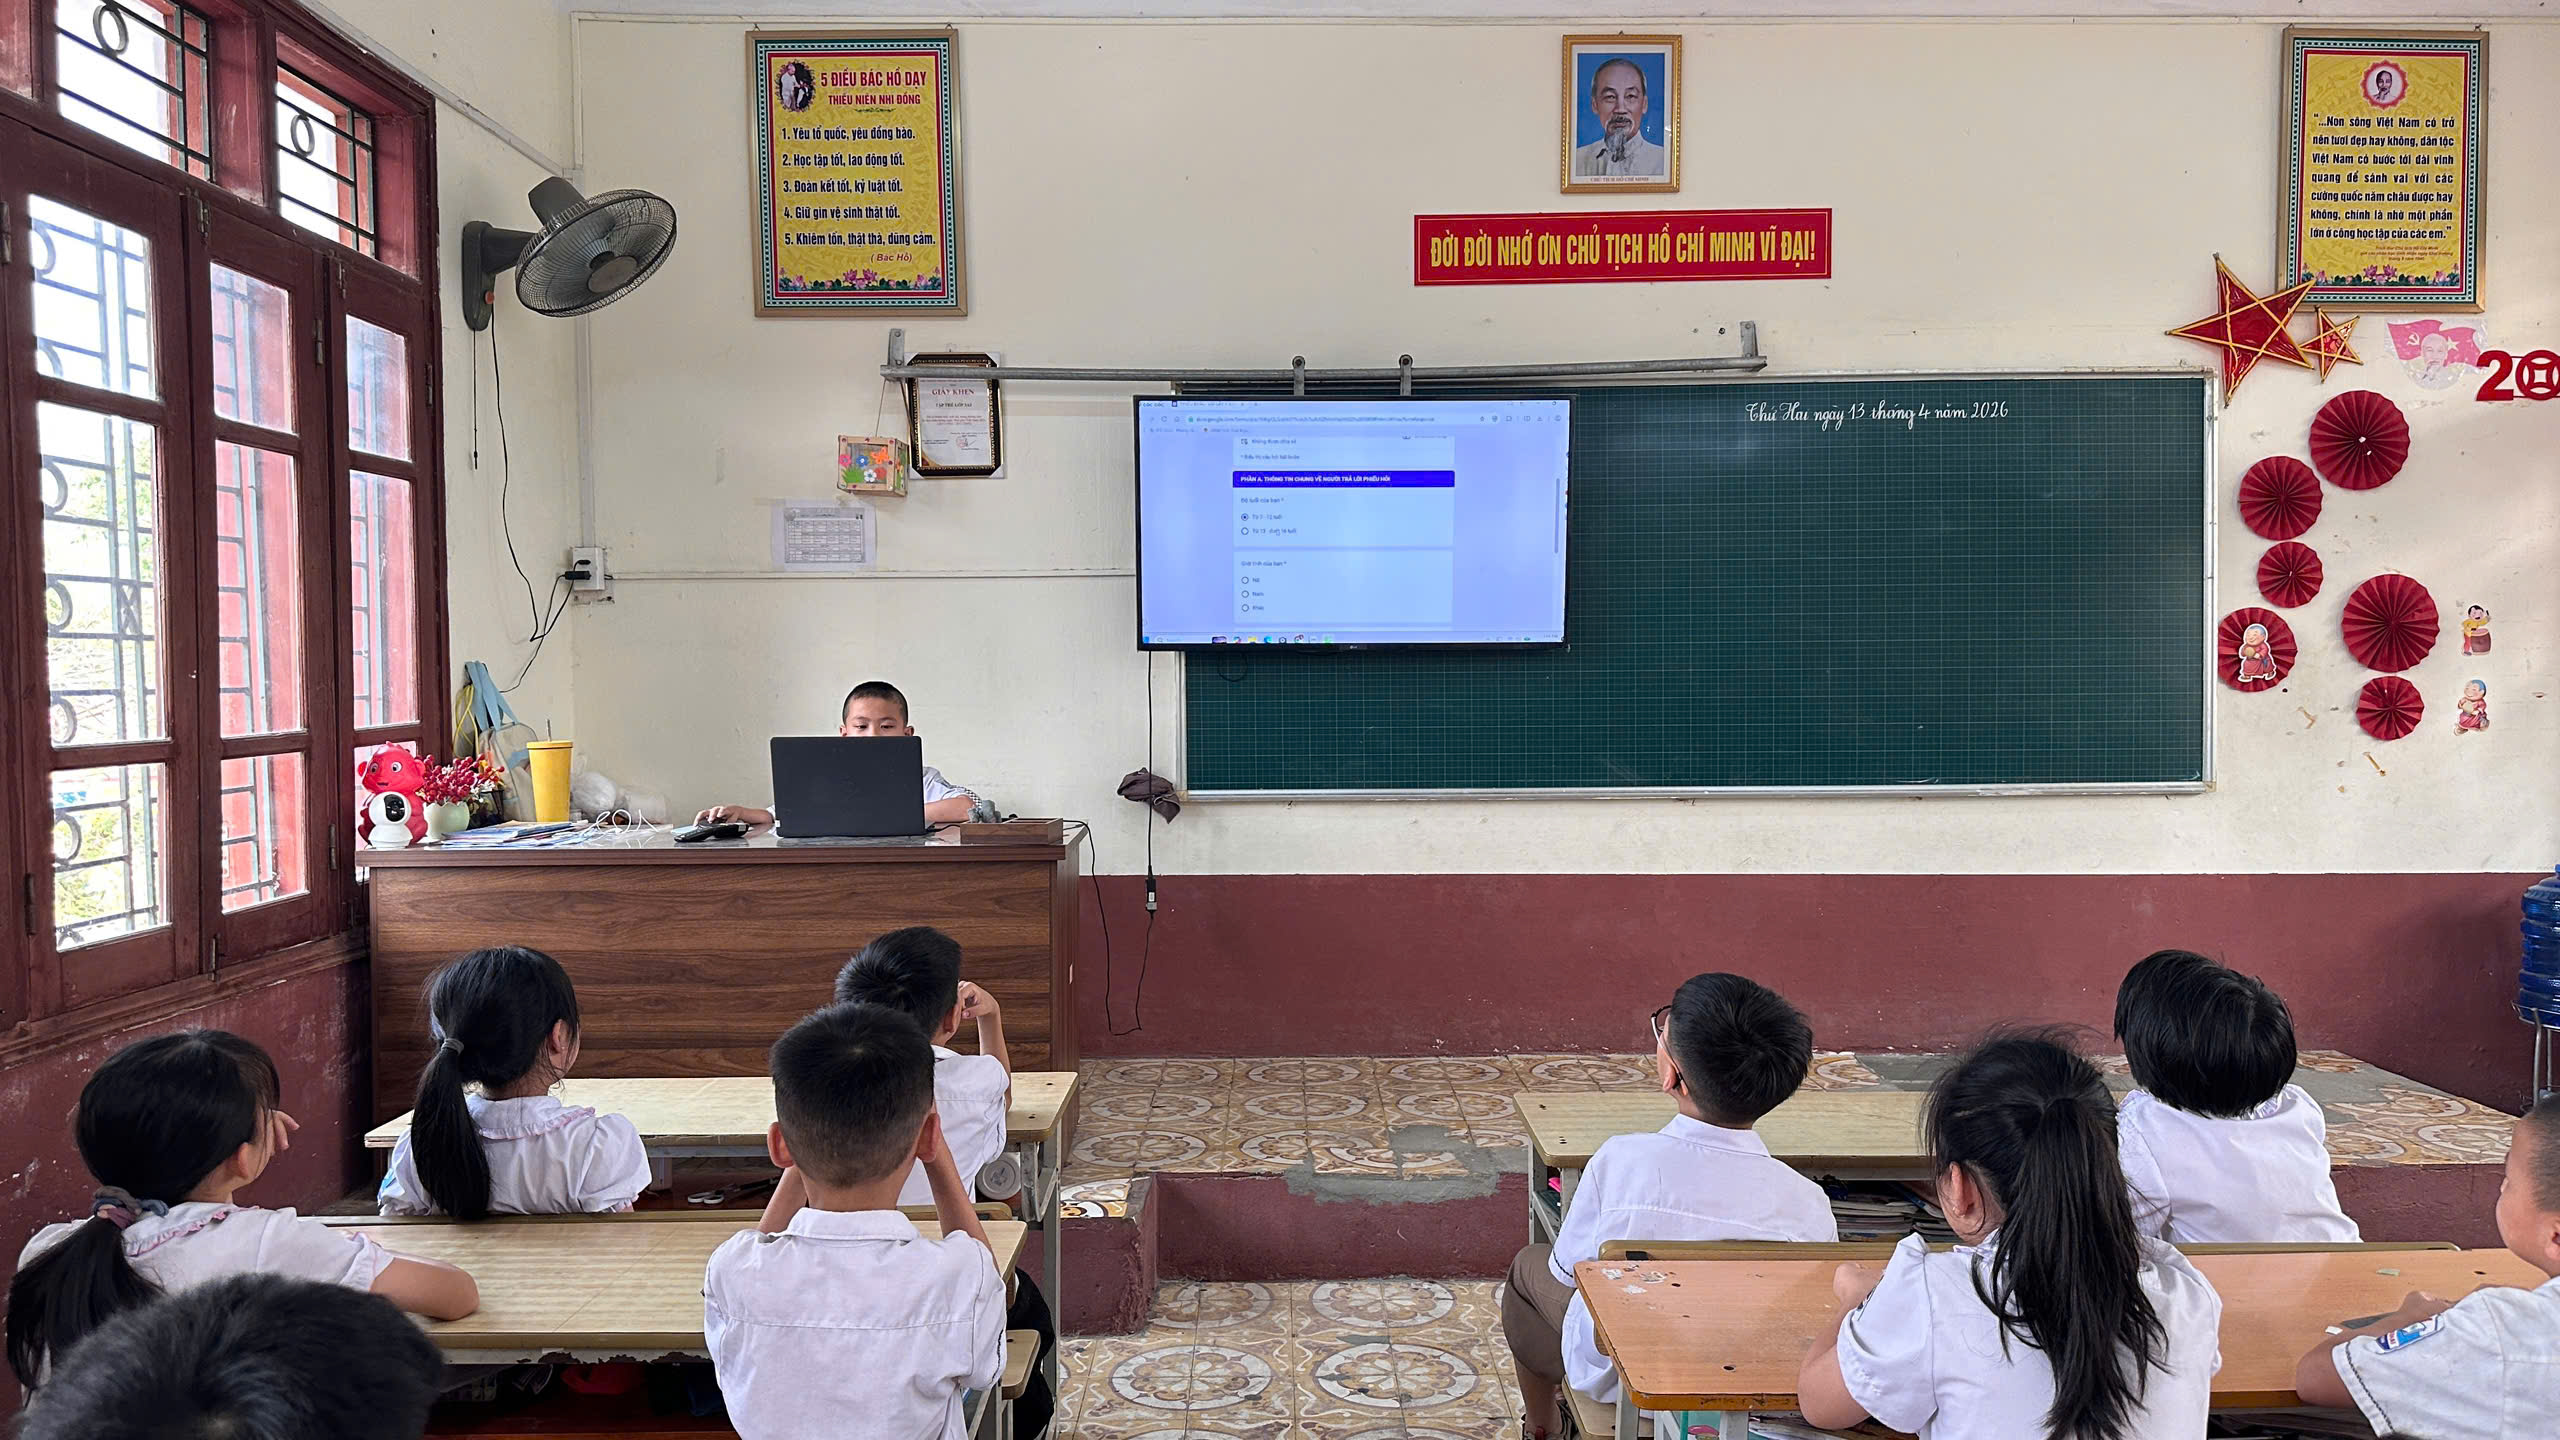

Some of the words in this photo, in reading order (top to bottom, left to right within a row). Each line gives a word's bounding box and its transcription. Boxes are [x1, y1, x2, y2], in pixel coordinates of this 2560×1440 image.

[821, 73, 827, 86] 5
[831, 67, 856, 86] ĐIỀU
[861, 69, 883, 86] BÁC
[887, 67, 901, 86] HỒ
[905, 72, 926, 89] DẠY
[828, 93, 852, 105] THIẾU
[856, 93, 876, 104] NIÊN
[879, 95, 894, 104] NHI
[897, 92, 920, 104] ĐỒNG
[2349, 117, 2371, 128] sông
[2376, 117, 2393, 129] Việt
[2398, 117, 2420, 128] Nam
[2425, 117, 2436, 128] có
[782, 128, 790, 140] 1.
[793, 127, 810, 139] Yêu
[824, 126, 849, 141] quốc,
[852, 128, 868, 141] yêu
[871, 125, 893, 141] đồng
[896, 127, 915, 139] bào.
[2313, 136, 2329, 144] nên
[2331, 135, 2348, 145] tươi
[2350, 135, 2366, 147] đẹp
[2369, 135, 2385, 146] hay
[2388, 136, 2418, 147] không,
[2420, 136, 2437, 146] dân
[2440, 136, 2454, 148] tộc
[782, 154, 791, 166] 2.
[794, 154, 811, 168] Học
[814, 154, 828, 168] tập
[831, 152, 846, 167] tốt,
[848, 154, 862, 166] lao
[866, 153, 887, 168] động
[890, 152, 904, 165] tốt.
[2312, 153, 2329, 166] Việt
[2333, 154, 2353, 164] Nam
[2358, 154, 2368, 164] có
[2373, 154, 2395, 164] bước
[2399, 154, 2411, 164] tới
[2415, 154, 2429, 164] đài
[2434, 155, 2454, 164] vinh
[2312, 173, 2341, 184] quang
[2364, 173, 2387, 182] sánh
[2394, 173, 2408, 182] vai
[2414, 173, 2429, 182] với
[2435, 173, 2453, 183] các
[783, 180, 792, 192] 3.
[794, 180, 817, 192] Đoàn
[820, 178, 835, 192] kết
[837, 178, 852, 194] tốt,
[868, 180, 886, 195] luật
[888, 178, 903, 192] tốt.
[2311, 191, 2338, 202] cường
[2341, 190, 2363, 202] quốc
[2365, 191, 2385, 201] năm
[2387, 191, 2409, 202] châu
[2411, 192, 2434, 204] được
[2436, 192, 2453, 202] hay
[784, 207, 793, 219] 4.
[796, 206, 810, 219] Giữ
[830, 206, 841, 221] vệ
[844, 207, 863, 219] sinh
[865, 206, 883, 221] thật
[885, 204, 900, 219] tốt.
[2310, 209, 2341, 220] không,
[2344, 209, 2370, 220] chính
[2374, 210, 2383, 220] là
[2408, 210, 2426, 222] một
[2430, 209, 2452, 221] phần
[785, 233, 793, 245] 5.
[796, 233, 825, 245] Khiêm
[828, 231, 845, 246] tốn,
[848, 233, 866, 247] thật
[868, 233, 886, 246] thà,
[888, 233, 910, 246] dũng
[913, 231, 936, 245] cảm.
[2310, 228, 2324, 238] lớn
[2333, 228, 2355, 239] công
[2357, 228, 2374, 240] học
[2375, 228, 2389, 240] tập
[2392, 227, 2408, 238] của
[2410, 228, 2427, 238] các
[1430, 231, 1459, 268] ĐỜI
[1463, 229, 1493, 267] ĐỜI
[1497, 229, 1533, 267] NHỚ
[1537, 233, 1561, 266] ƠN
[1566, 224, 1600, 265] CHỦ
[1605, 233, 1643, 271] TỊCH
[1648, 223, 1671, 264] HỒ
[1675, 226, 1704, 263] CHÍ
[1709, 231, 1755, 262] MINH
[1760, 225, 1777, 262] VĨ
[1781, 230, 1816, 268] ĐẠI!
[1745, 402, 1776, 422] Thứ
[1779, 402, 1808, 421] Hai
[1814, 404, 1845, 431] ngày
[1847, 402, 1865, 421] 13
[1870, 400, 1916, 430] tháng
[1918, 403, 1931, 420] 4
[1935, 404, 1968, 419] năm
[1971, 400, 2009, 418] 2026
